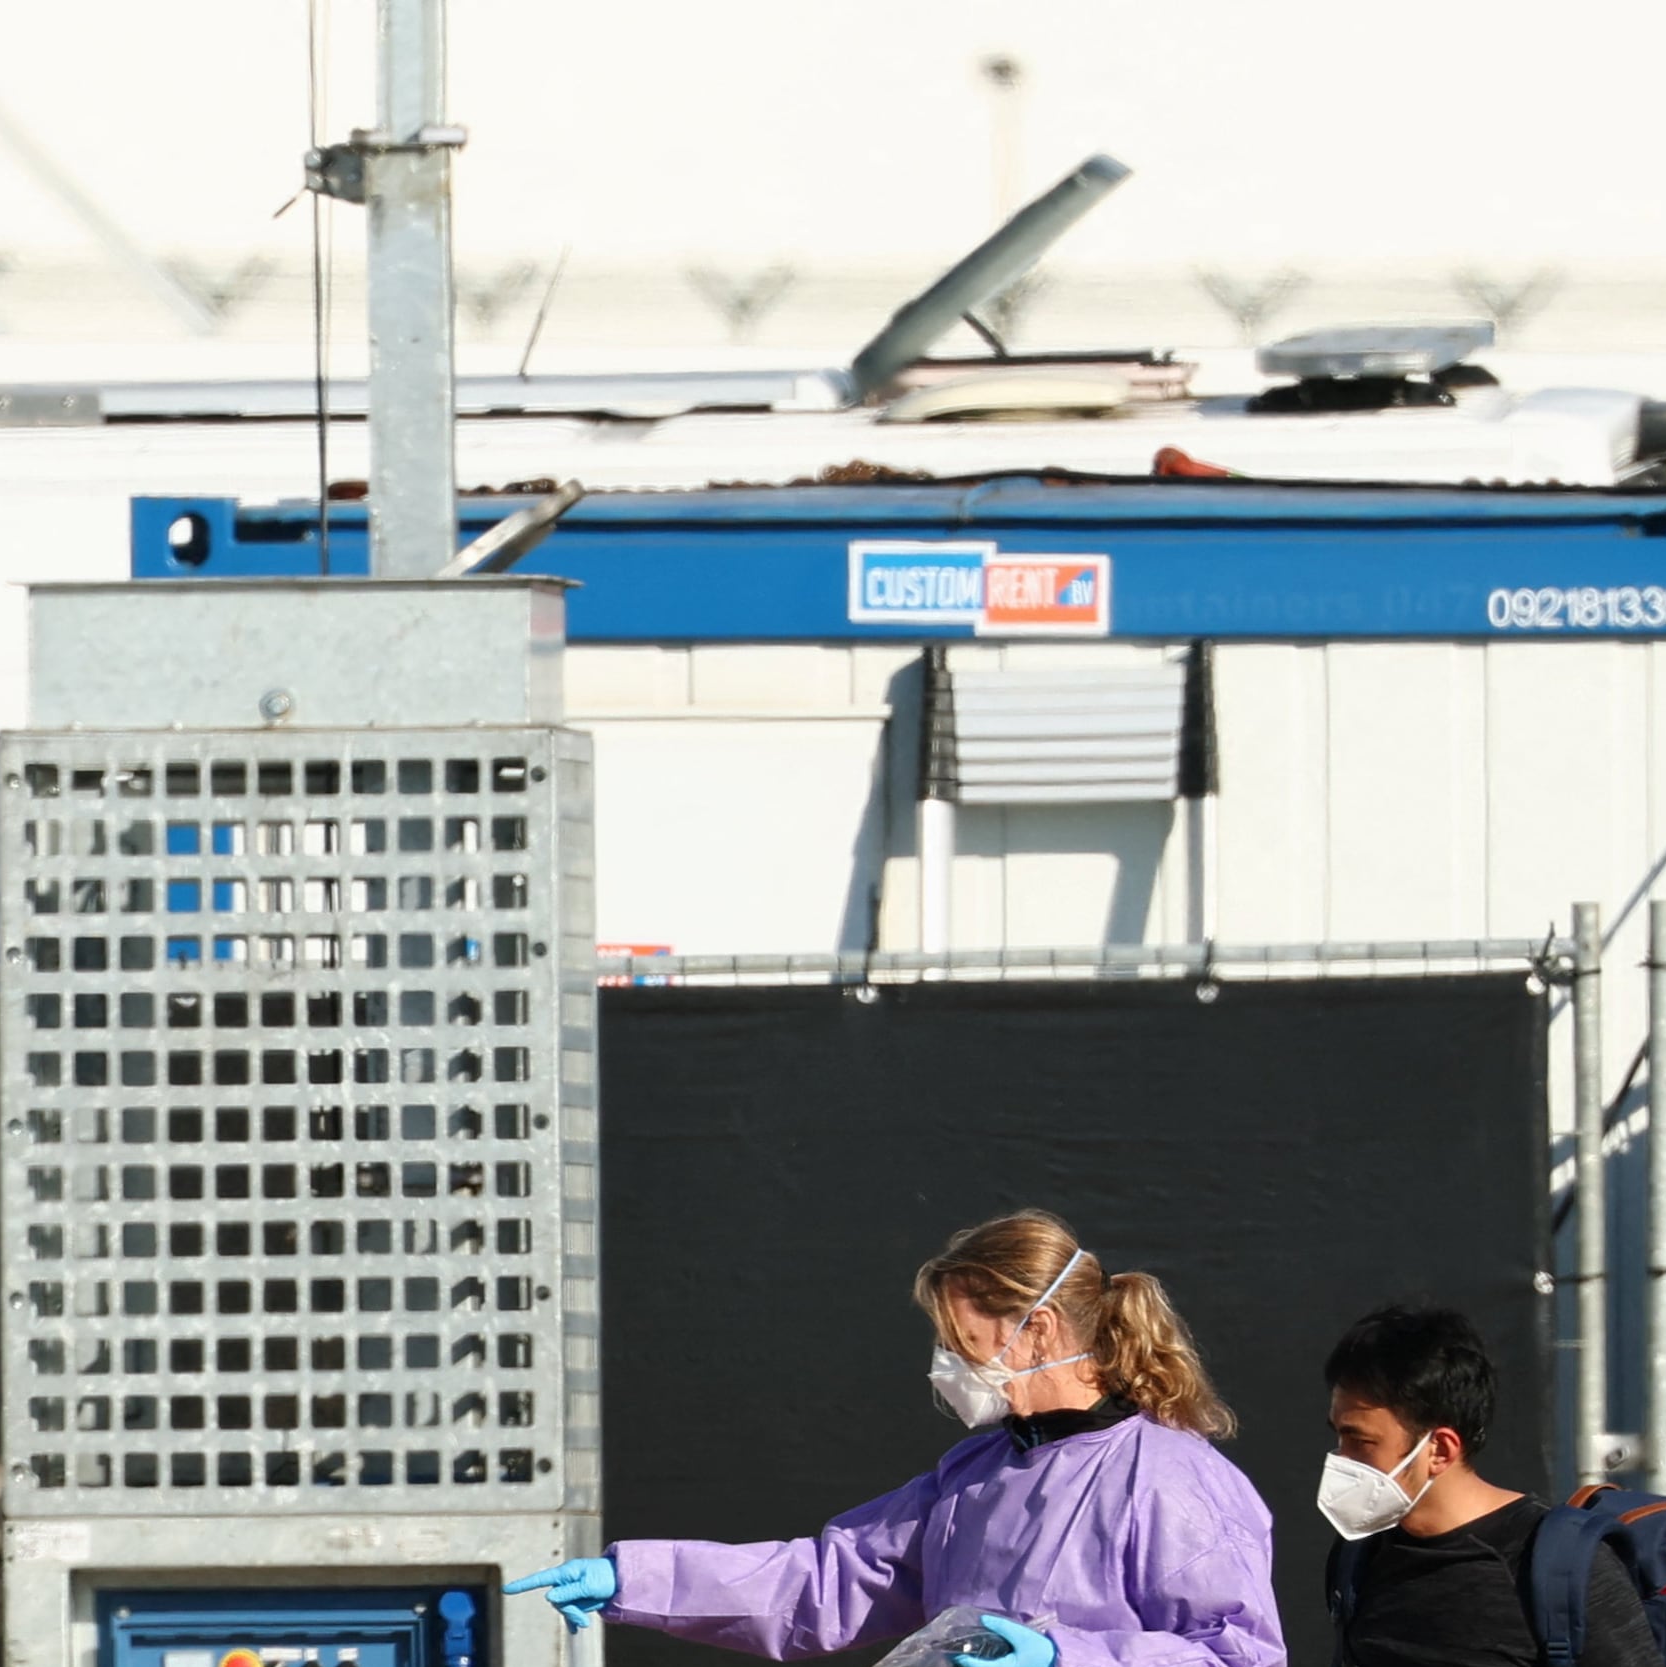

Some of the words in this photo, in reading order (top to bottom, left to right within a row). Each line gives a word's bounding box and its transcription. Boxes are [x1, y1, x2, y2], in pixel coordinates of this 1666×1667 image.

[866, 567, 981, 609] CUSTOM
[987, 566, 1059, 609] RENT
[1070, 579, 1095, 605] BV
